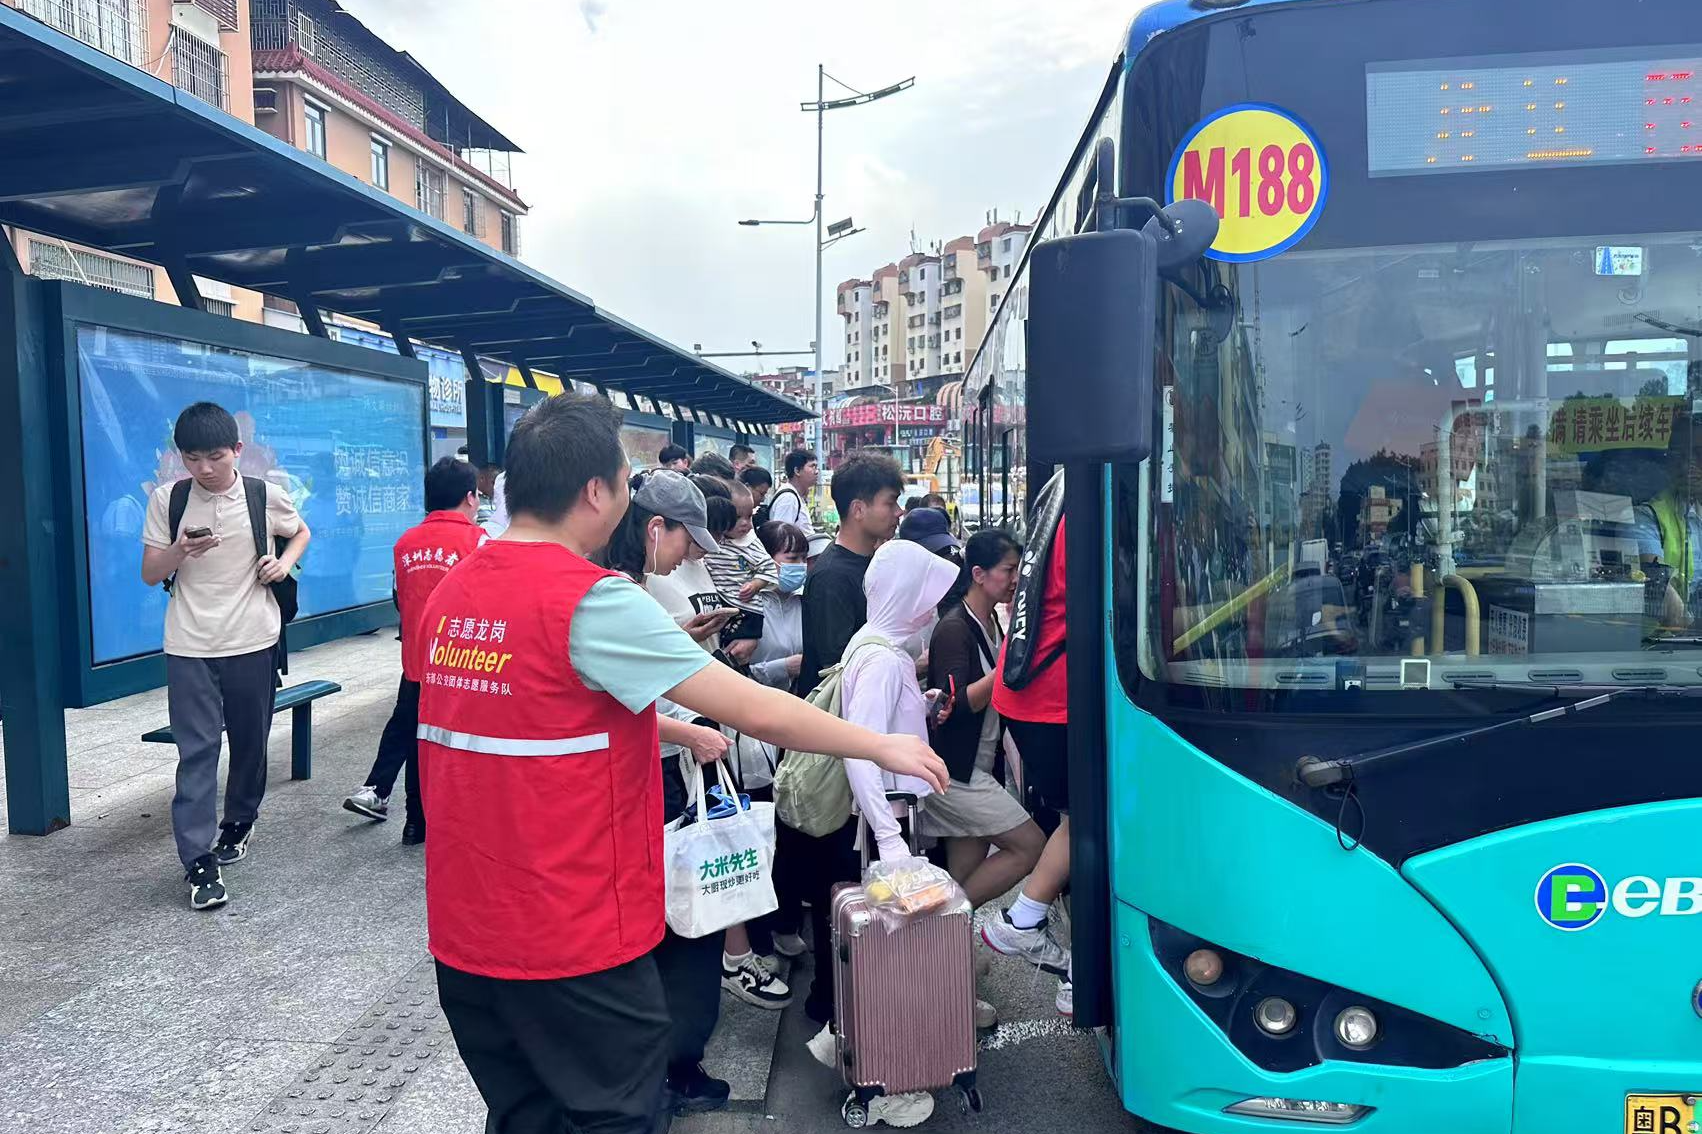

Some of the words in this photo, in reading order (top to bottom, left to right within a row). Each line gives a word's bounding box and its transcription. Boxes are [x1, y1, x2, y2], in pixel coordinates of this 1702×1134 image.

[1183, 142, 1314, 219] M188
[437, 616, 447, 634] I
[447, 617, 507, 643] 志愿龙岗
[429, 637, 512, 673] Volunteer
[700, 847, 759, 881] 大米先生
[701, 870, 760, 896] 大厨现炒更好吃
